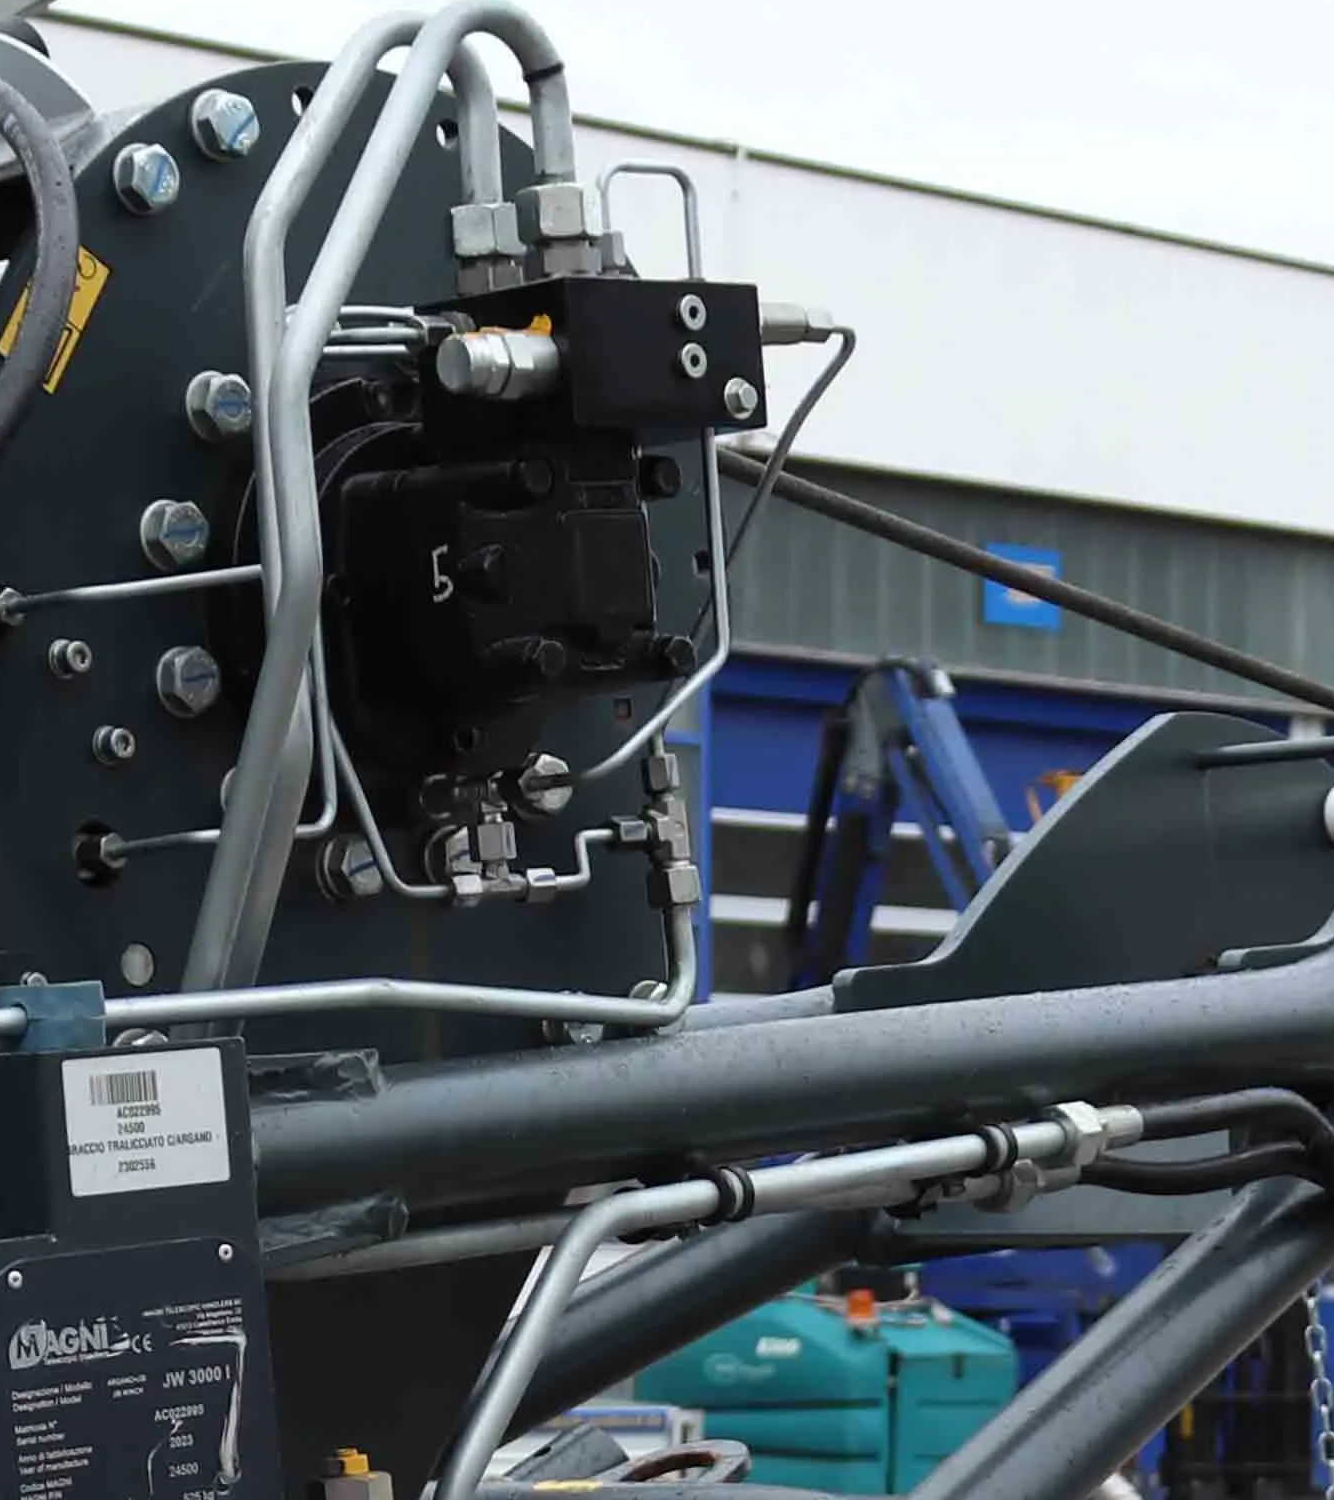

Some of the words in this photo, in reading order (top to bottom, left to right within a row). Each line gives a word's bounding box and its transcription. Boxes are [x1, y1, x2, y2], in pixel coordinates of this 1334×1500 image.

[432, 544, 454, 602] 5
[118, 1121, 145, 1135] 24500
[9, 1323, 109, 1370] MAGNI
[132, 1332, 152, 1354] CE
[163, 1371, 188, 1389] JW
[189, 1366, 222, 1387] 3000
[169, 1461, 200, 1479] 24500
